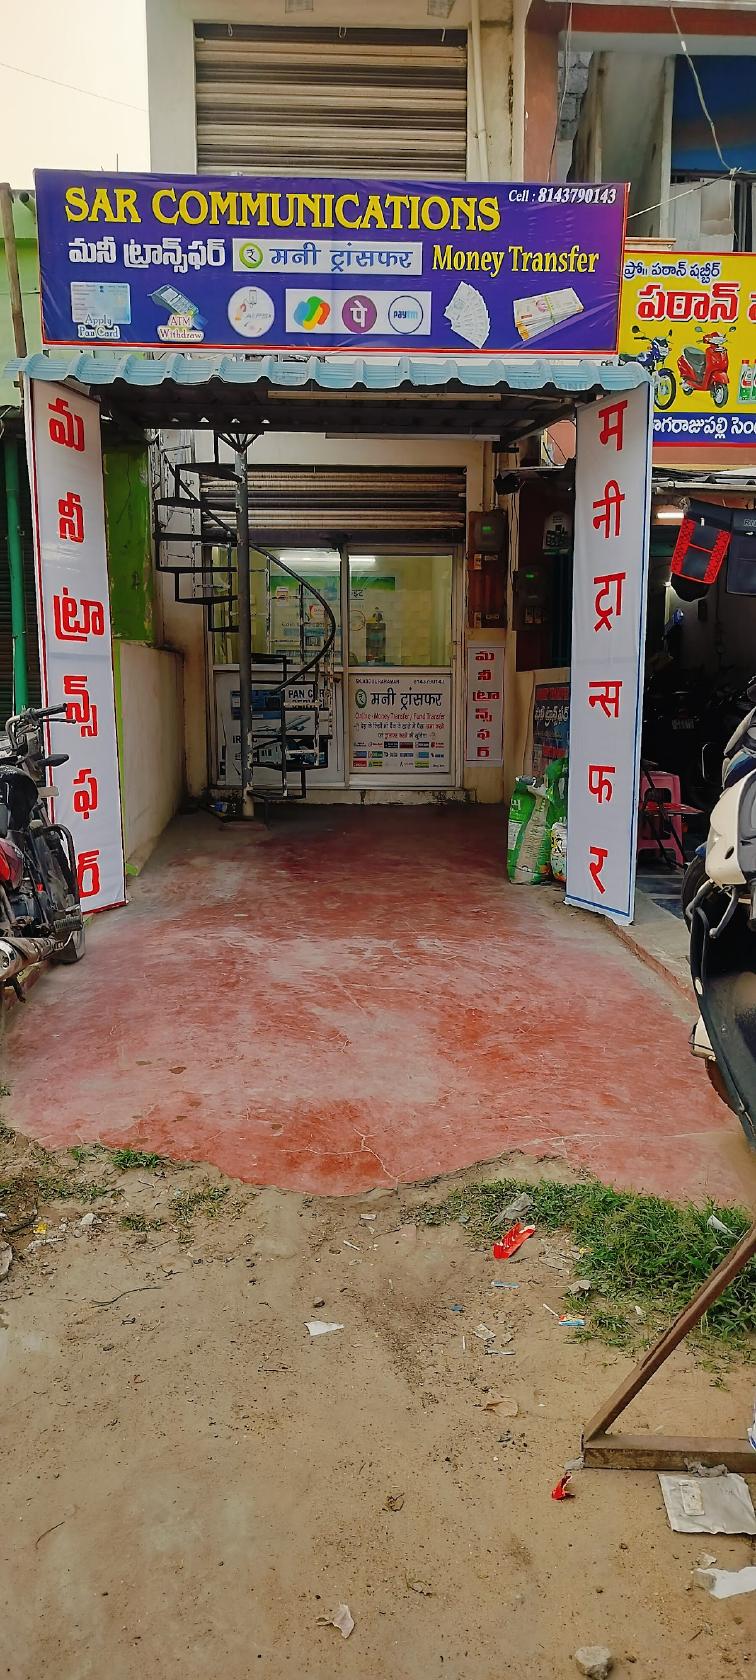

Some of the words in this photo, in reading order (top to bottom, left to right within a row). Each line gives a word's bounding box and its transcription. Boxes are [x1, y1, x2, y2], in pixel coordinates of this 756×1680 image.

[508, 189, 529, 202] Cell
[537, 188, 617, 204] 8143790143
[65, 187, 141, 223] SAR
[152, 188, 500, 231] COMMUNICATIONS
[68, 236, 117, 264] మనీ
[269, 242, 322, 266] मनी
[330, 242, 413, 272] ट्रांसफर
[432, 245, 504, 278] Money
[508, 246, 599, 273] Transfer
[651, 261, 686, 277] పఠాన్
[637, 283, 740, 321] పఠాన్
[85, 314, 112, 326] Apply
[171, 316, 191, 326] ATM
[79, 327, 95, 337] Pan
[97, 326, 119, 338] Card
[160, 328, 202, 339] Withdraw
[288, 689, 304, 698] PAN
[370, 687, 396, 706] मनी
[400, 687, 443, 711] ट्रांसफर
